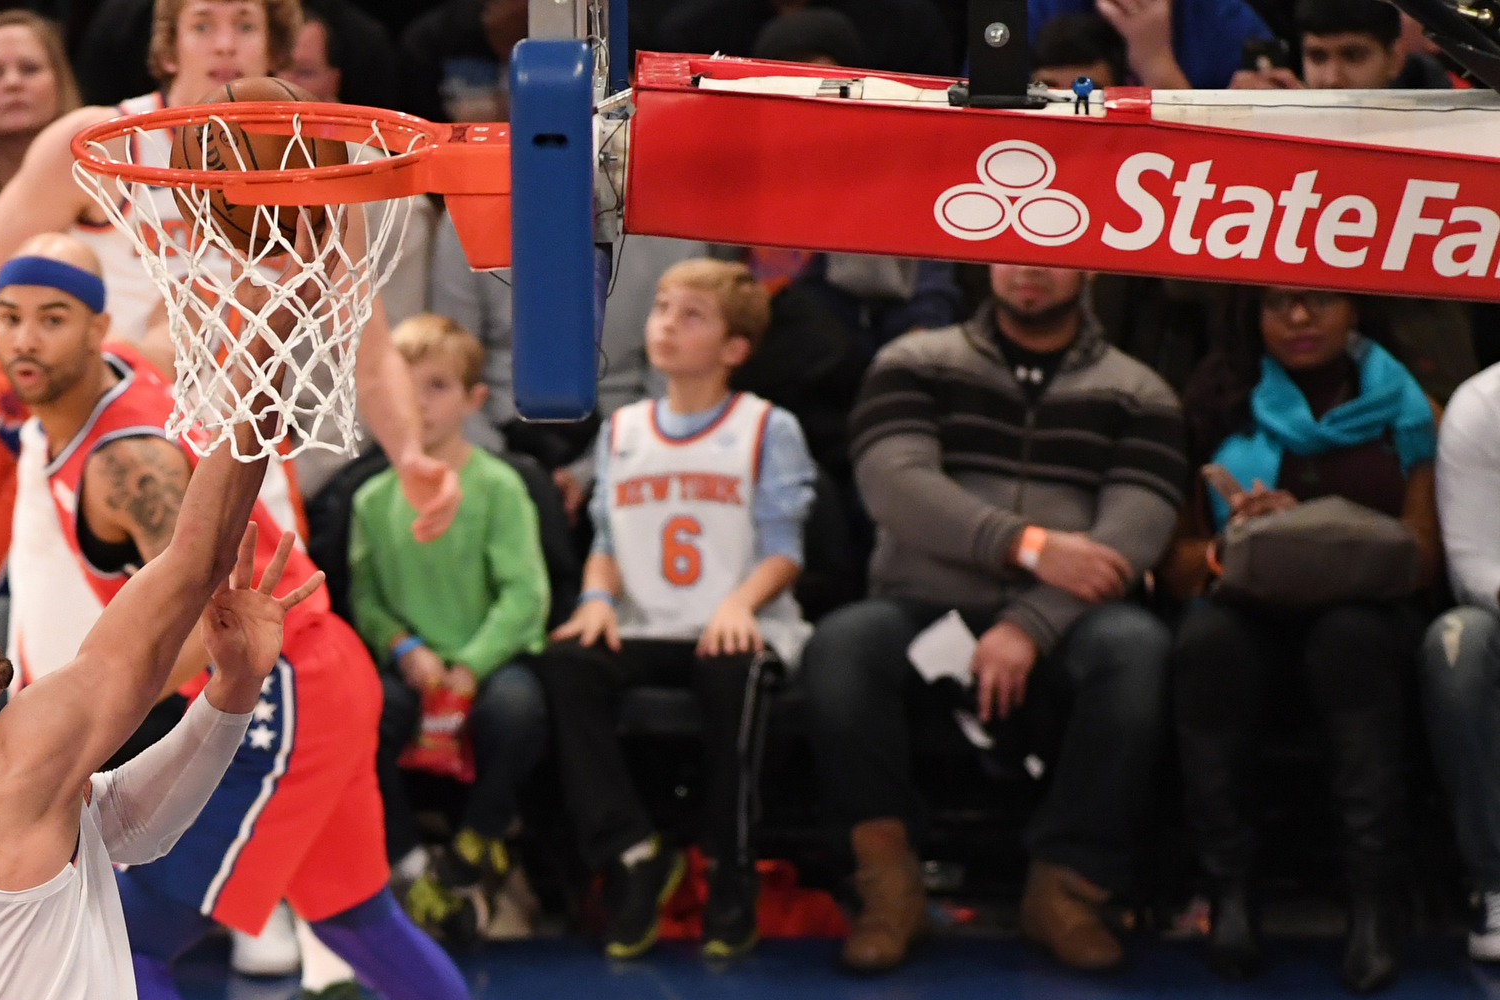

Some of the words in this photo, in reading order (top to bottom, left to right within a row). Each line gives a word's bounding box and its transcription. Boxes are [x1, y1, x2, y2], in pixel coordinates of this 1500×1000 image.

[1100, 151, 1378, 269] State
[1380, 178, 1500, 280] Fa
[661, 515, 703, 588] 6
